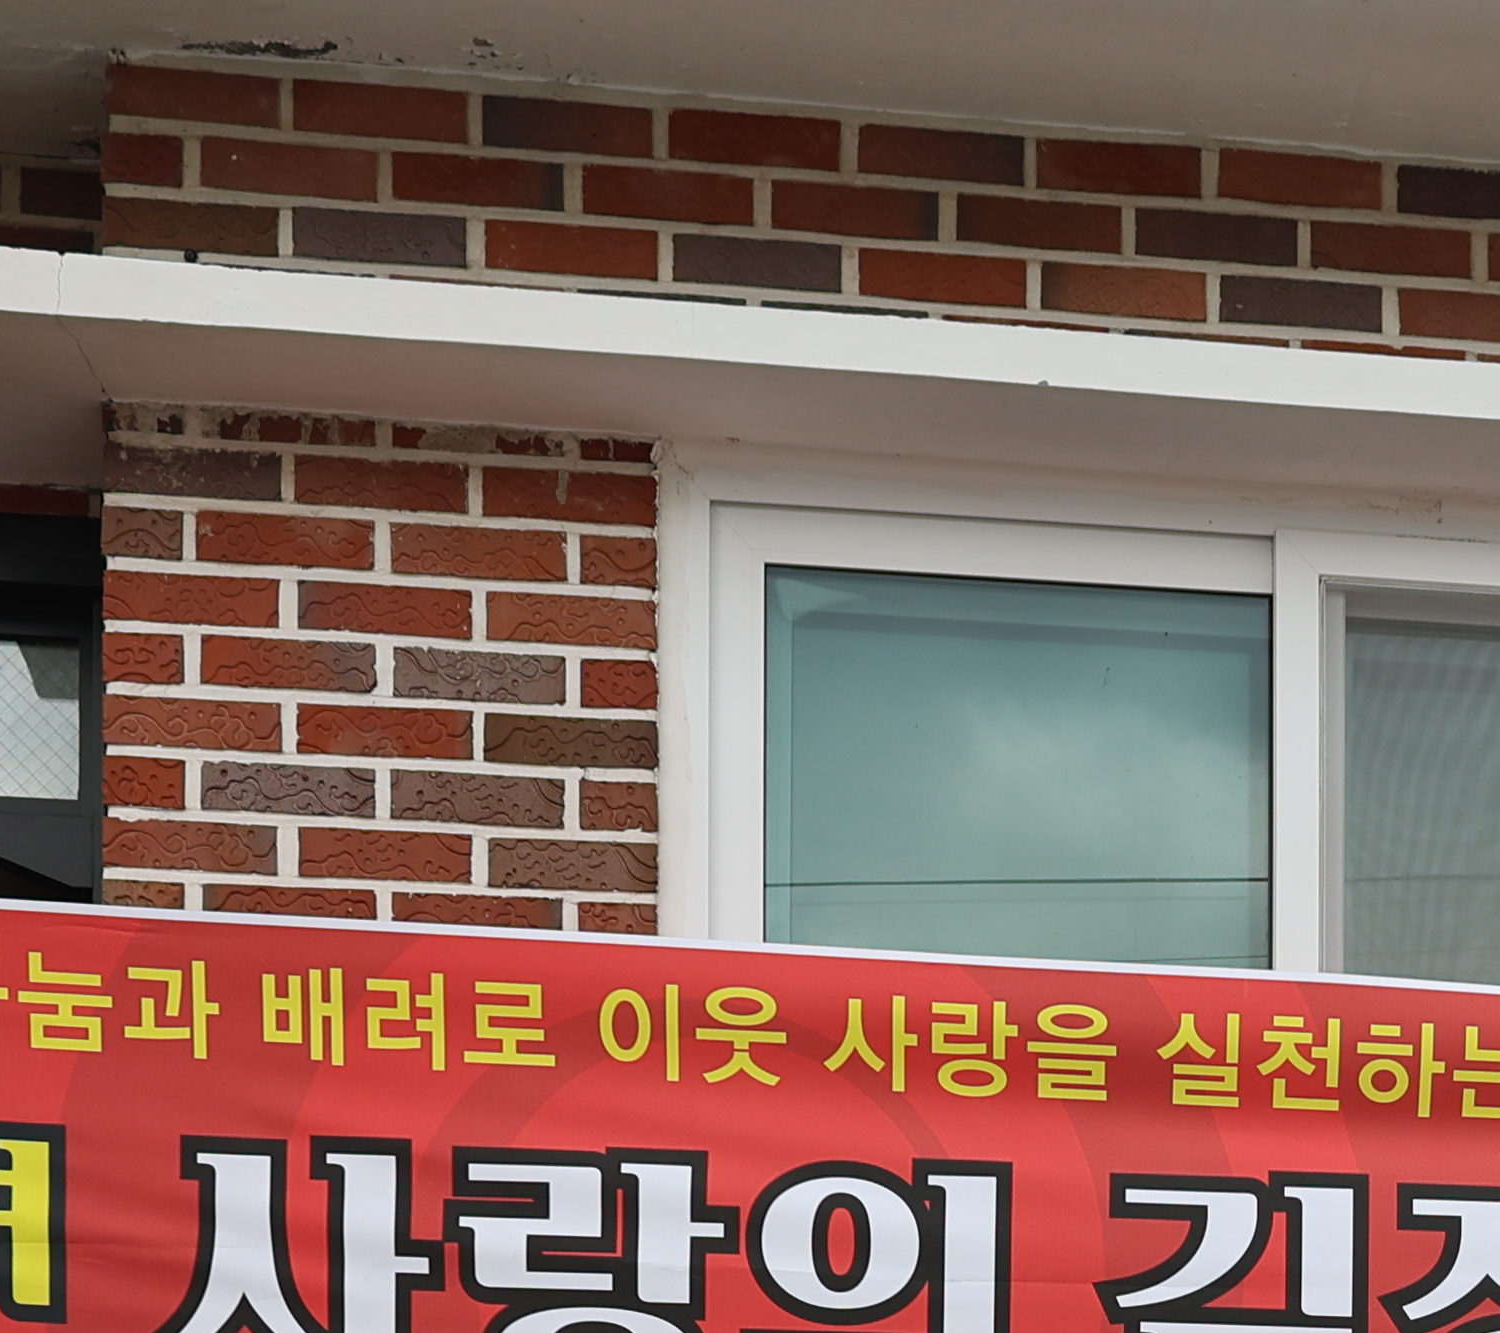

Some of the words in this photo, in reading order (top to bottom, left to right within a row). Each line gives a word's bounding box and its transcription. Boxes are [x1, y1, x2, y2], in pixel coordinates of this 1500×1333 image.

[261, 966, 557, 1072] 배려로
[598, 983, 789, 1087] 이웃
[823, 994, 1119, 1102] 사랑을
